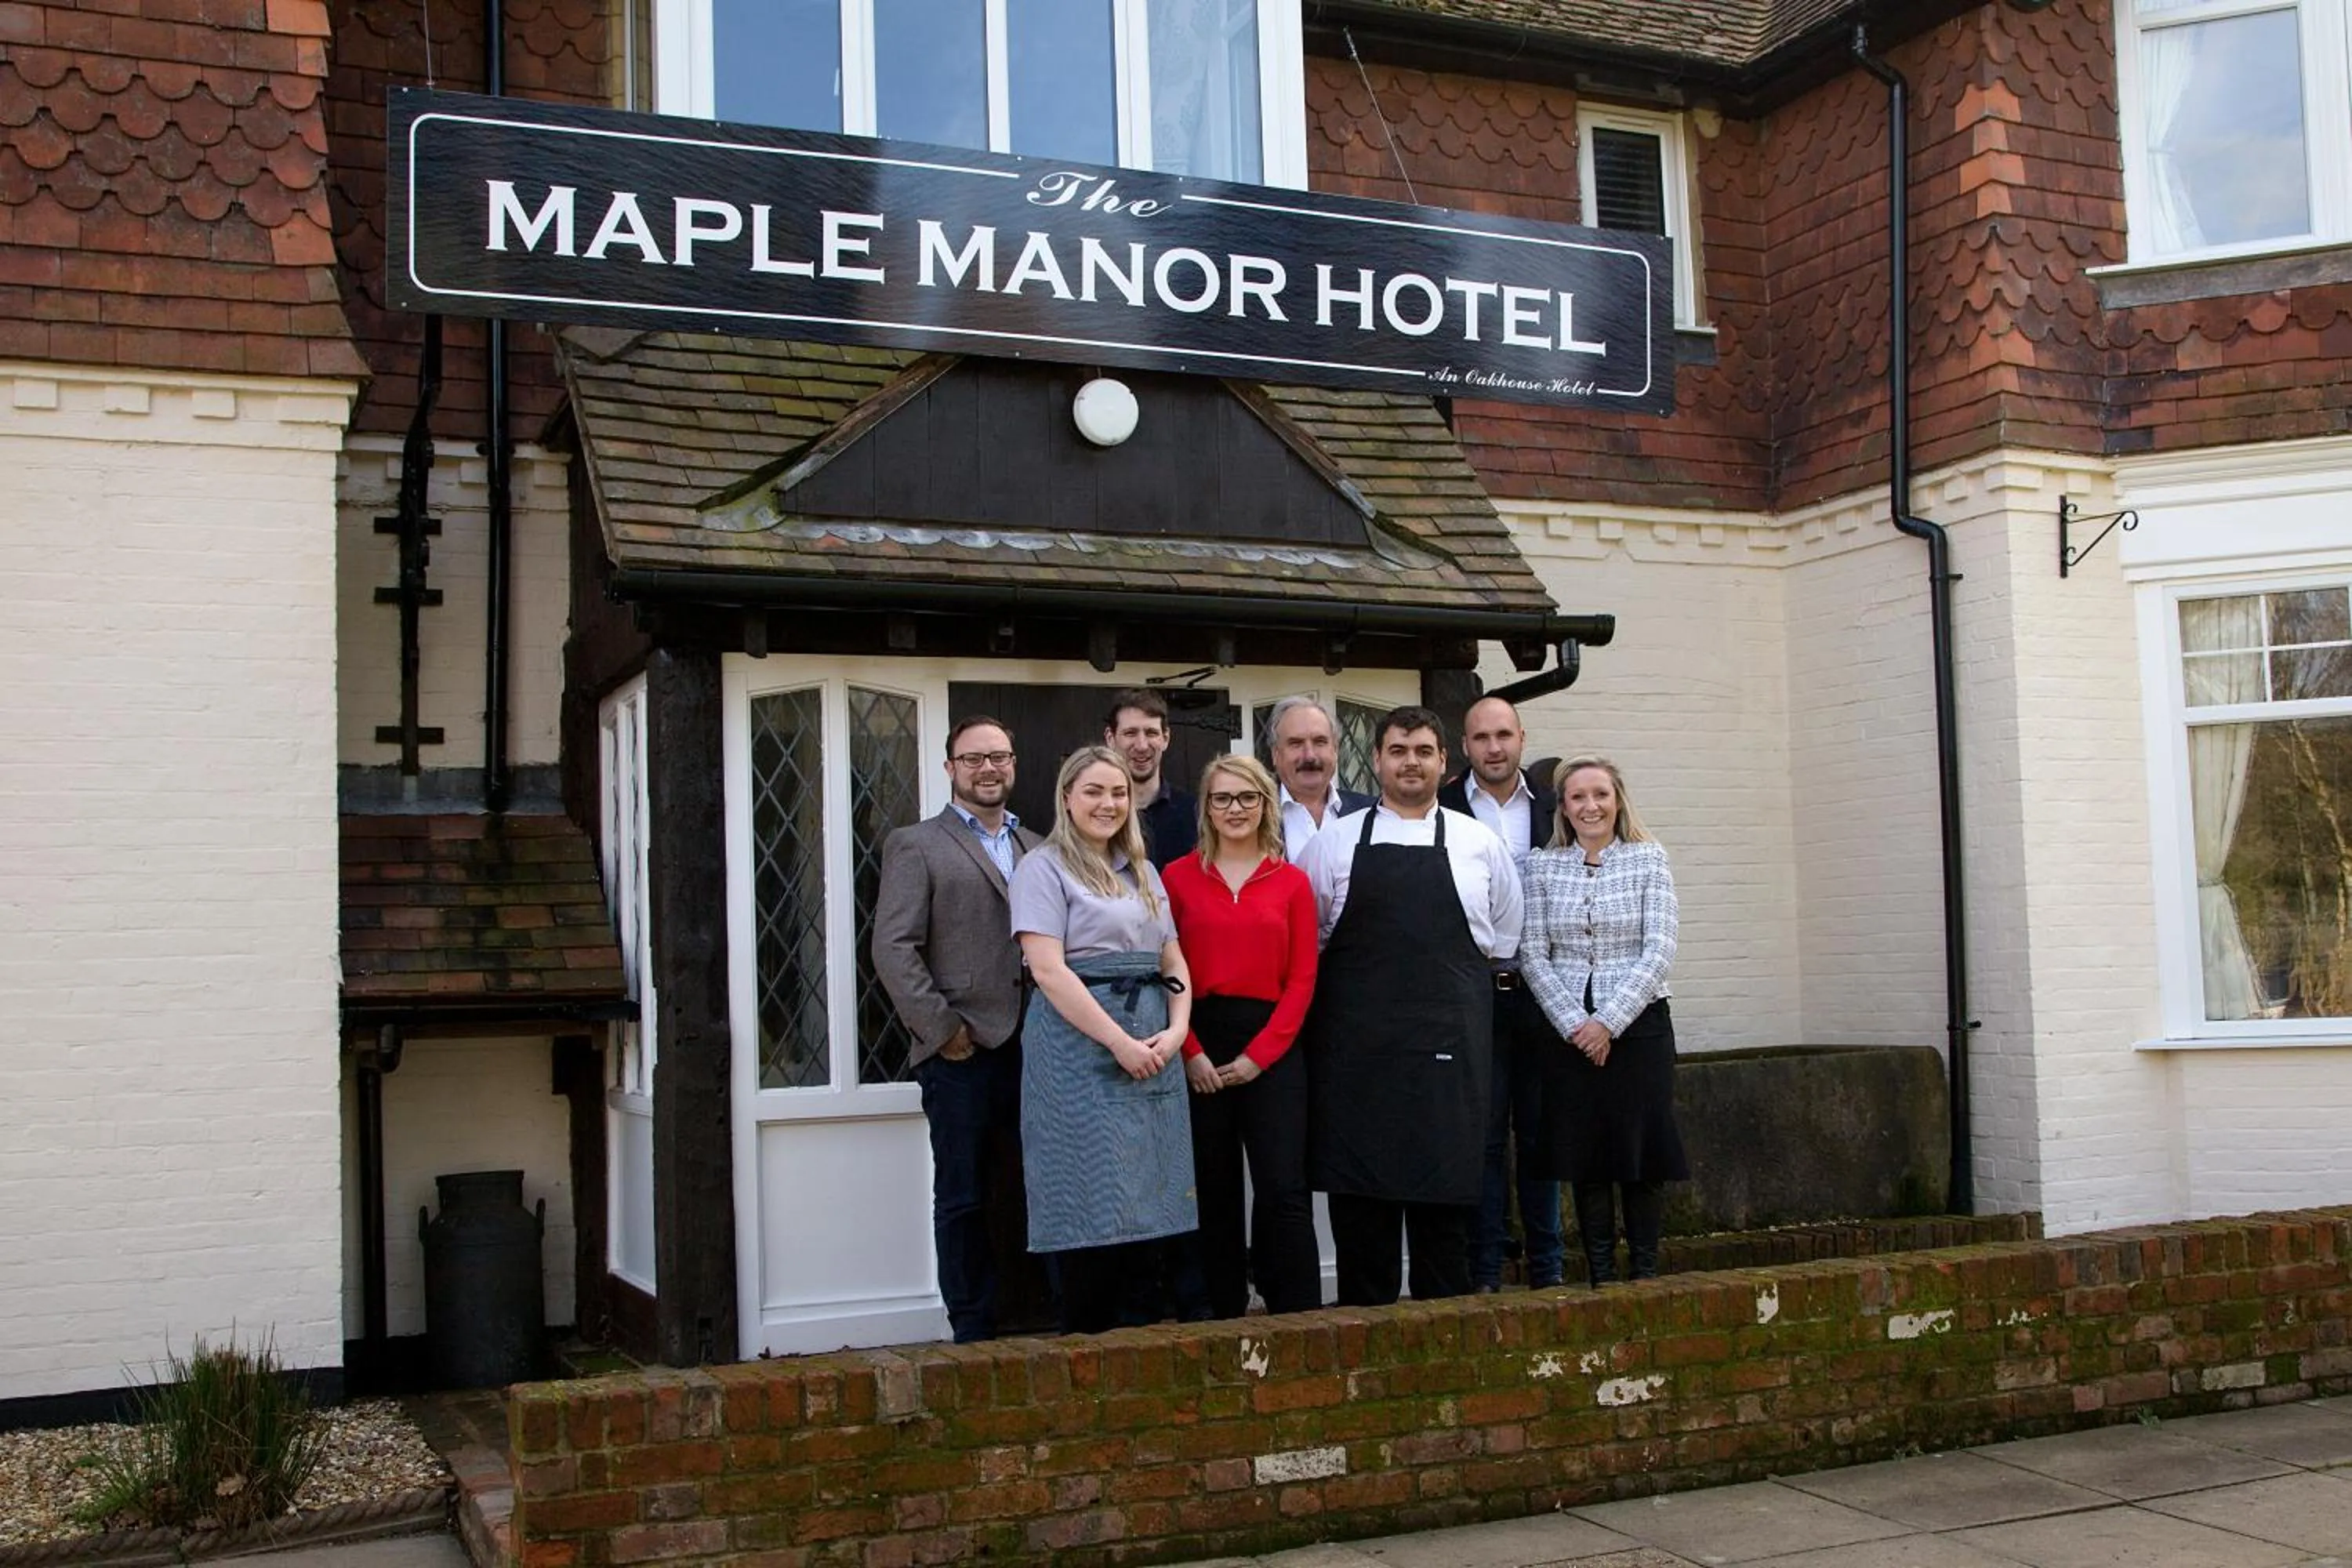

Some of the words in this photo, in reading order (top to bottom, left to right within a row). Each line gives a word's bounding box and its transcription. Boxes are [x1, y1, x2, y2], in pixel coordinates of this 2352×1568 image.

[1026, 172, 1174, 217] The
[485, 180, 885, 285] MAPLE
[916, 219, 1290, 322] MANOR
[1315, 263, 1606, 358] HOTEL
[1428, 366, 1459, 383] An
[1465, 369, 1543, 391] Oakhouse
[1545, 377, 1595, 396] Hotel
